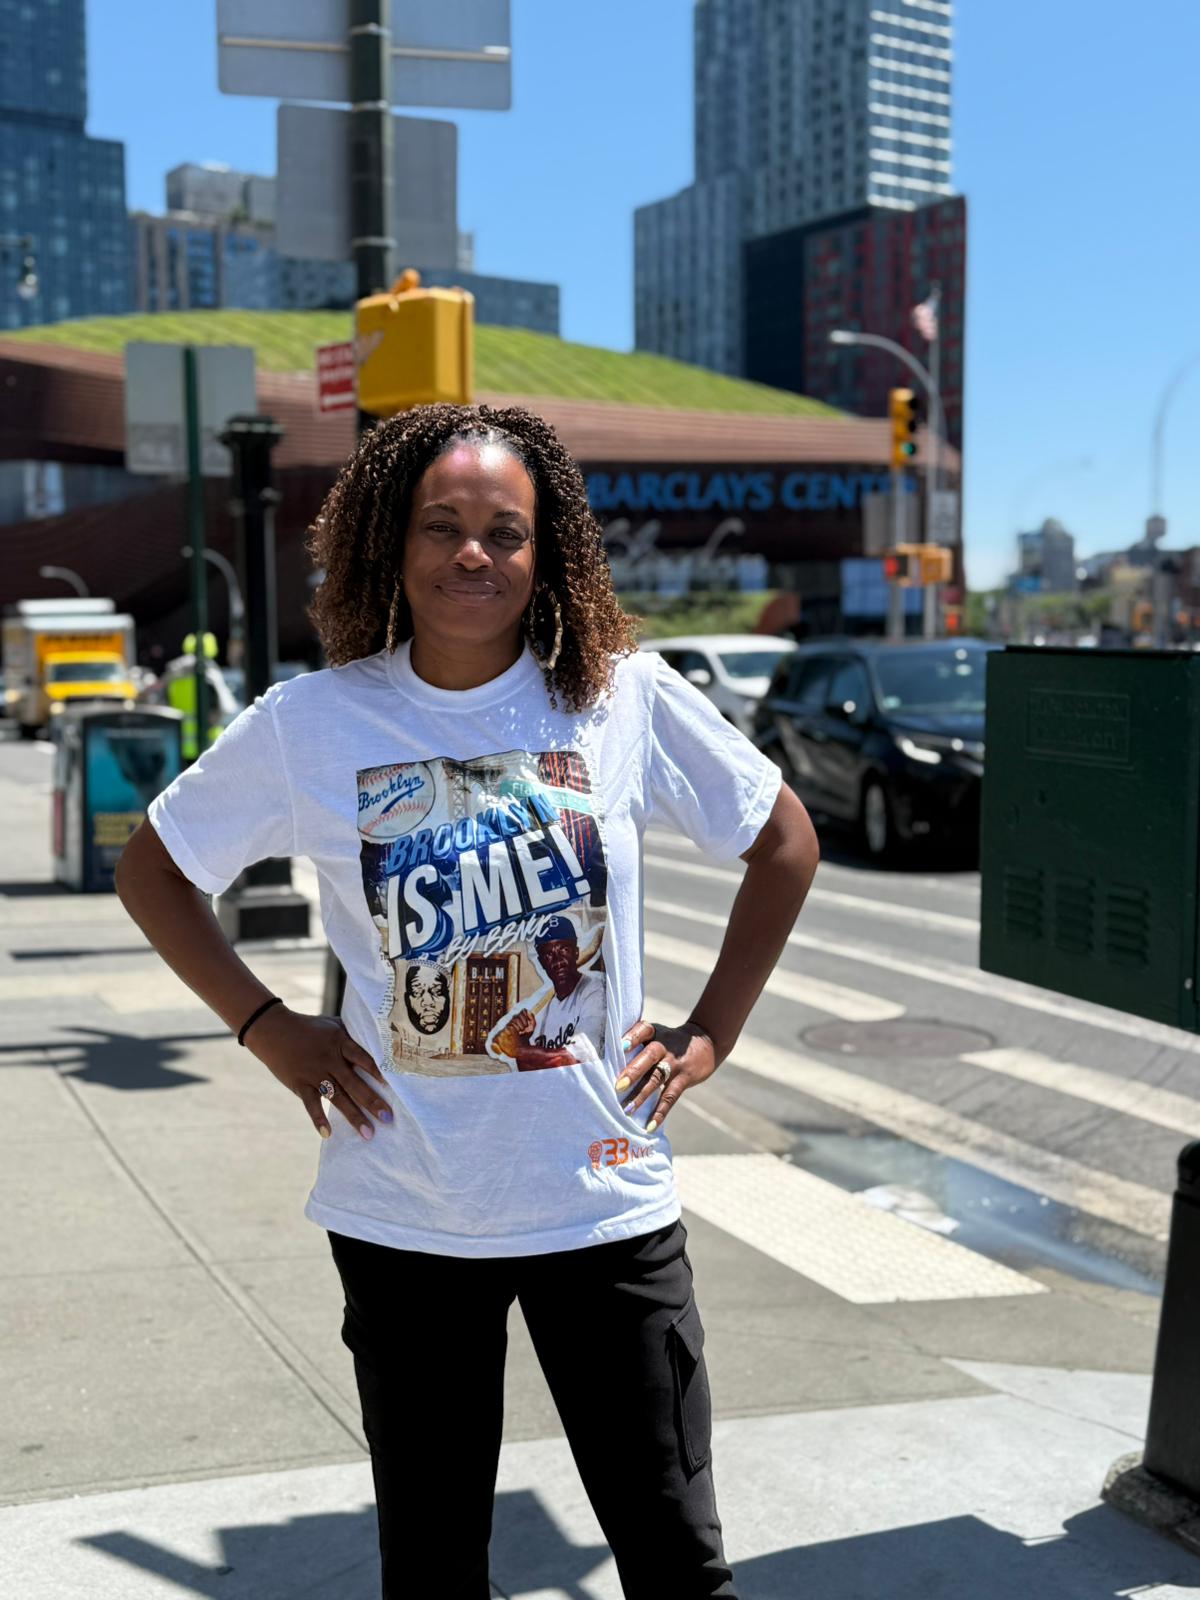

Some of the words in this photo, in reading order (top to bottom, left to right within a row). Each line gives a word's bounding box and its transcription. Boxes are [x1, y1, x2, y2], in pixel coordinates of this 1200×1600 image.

[586, 471, 774, 511] BARCLAYS
[358, 773, 424, 812] Brooklyn
[384, 792, 562, 877] BROOKLYN
[387, 863, 452, 960] IS
[458, 823, 592, 934] ME!
